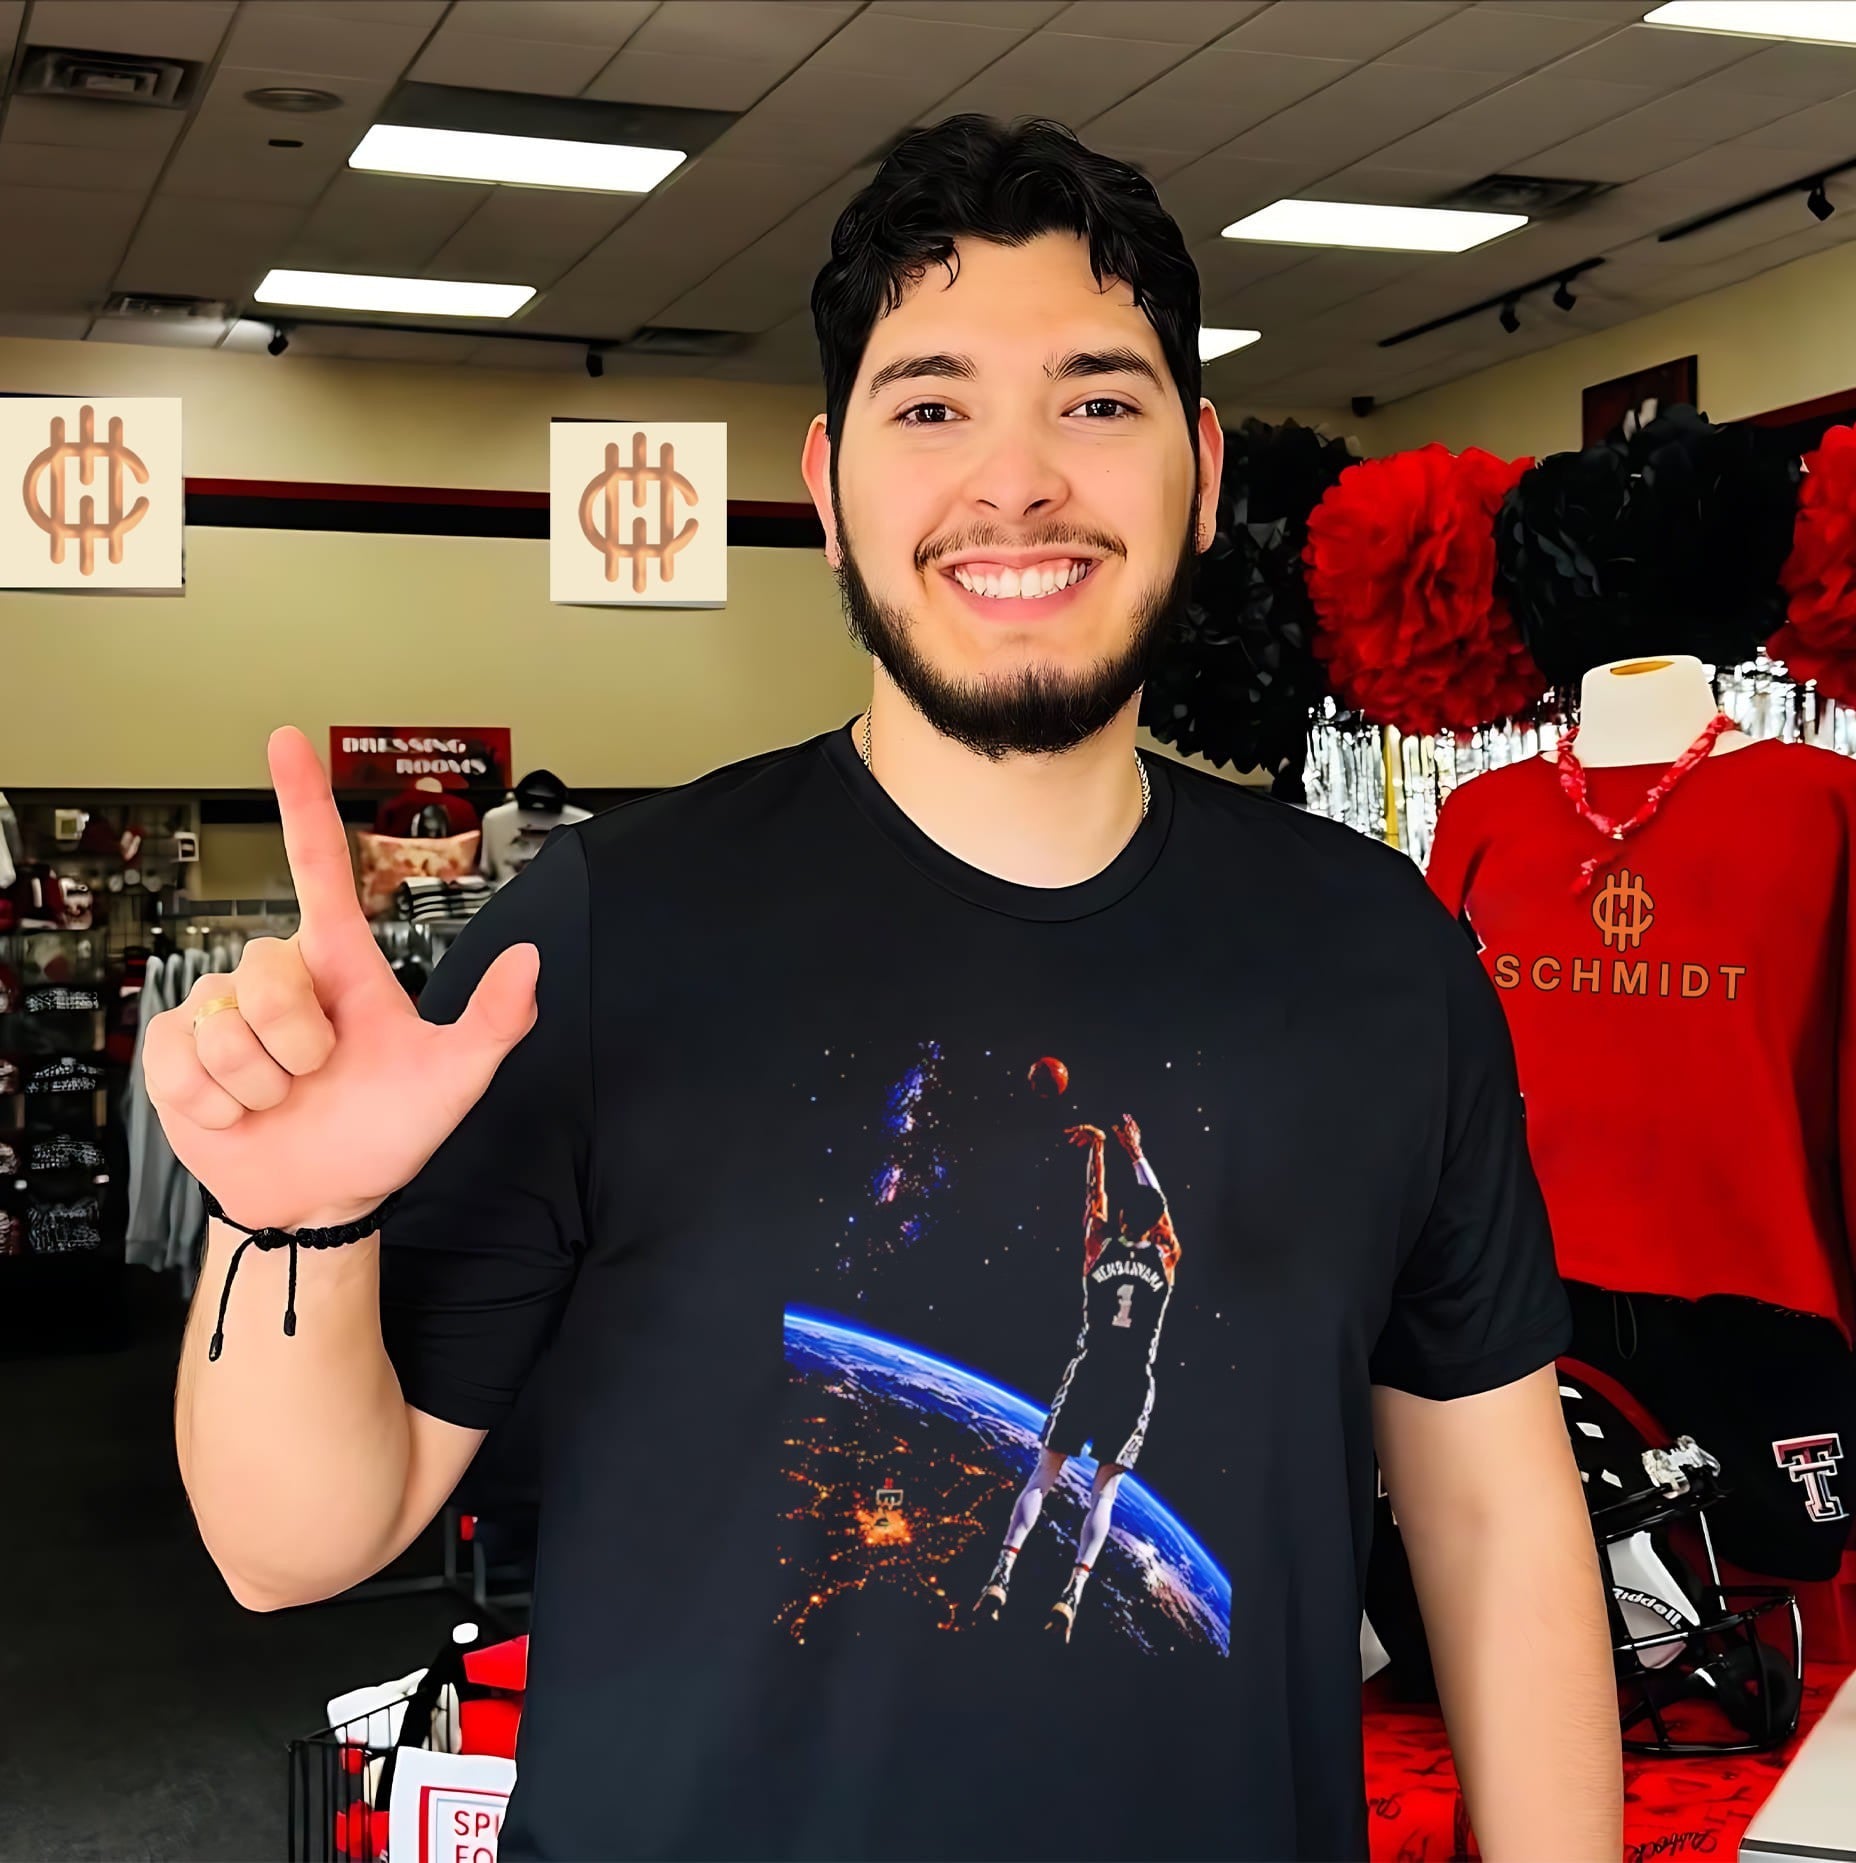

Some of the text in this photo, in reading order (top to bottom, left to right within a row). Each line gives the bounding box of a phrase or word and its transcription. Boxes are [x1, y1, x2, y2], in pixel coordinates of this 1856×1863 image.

[341, 737, 467, 754] DRESSING
[395, 758, 487, 775] ROOMS
[1494, 953, 1747, 1000] SCHMIDT
[1111, 1283, 1135, 1328] 1
